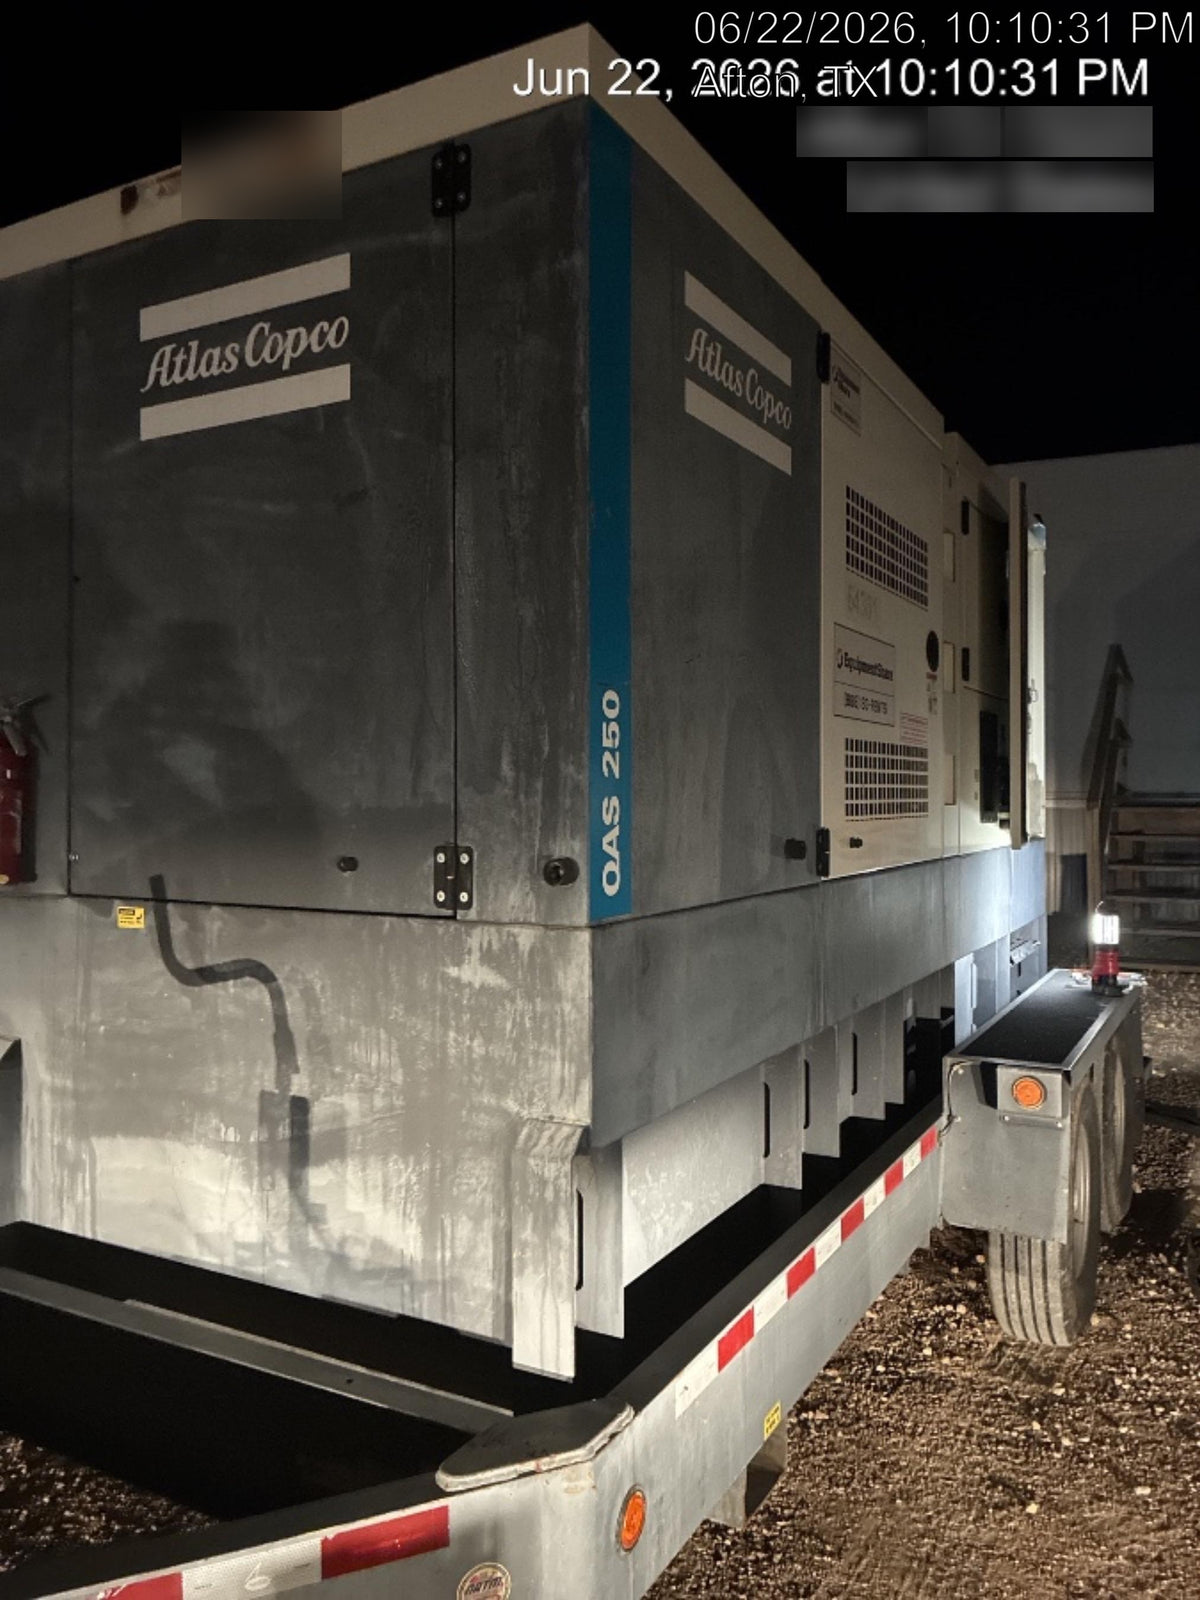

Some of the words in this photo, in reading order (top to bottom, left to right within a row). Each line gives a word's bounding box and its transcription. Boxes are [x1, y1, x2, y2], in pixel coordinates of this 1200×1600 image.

[140, 339, 240, 393] Atlas
[244, 316, 350, 371] Copco
[685, 328, 744, 397] Atlas
[745, 368, 792, 430] Copco
[602, 689, 621, 780] 250
